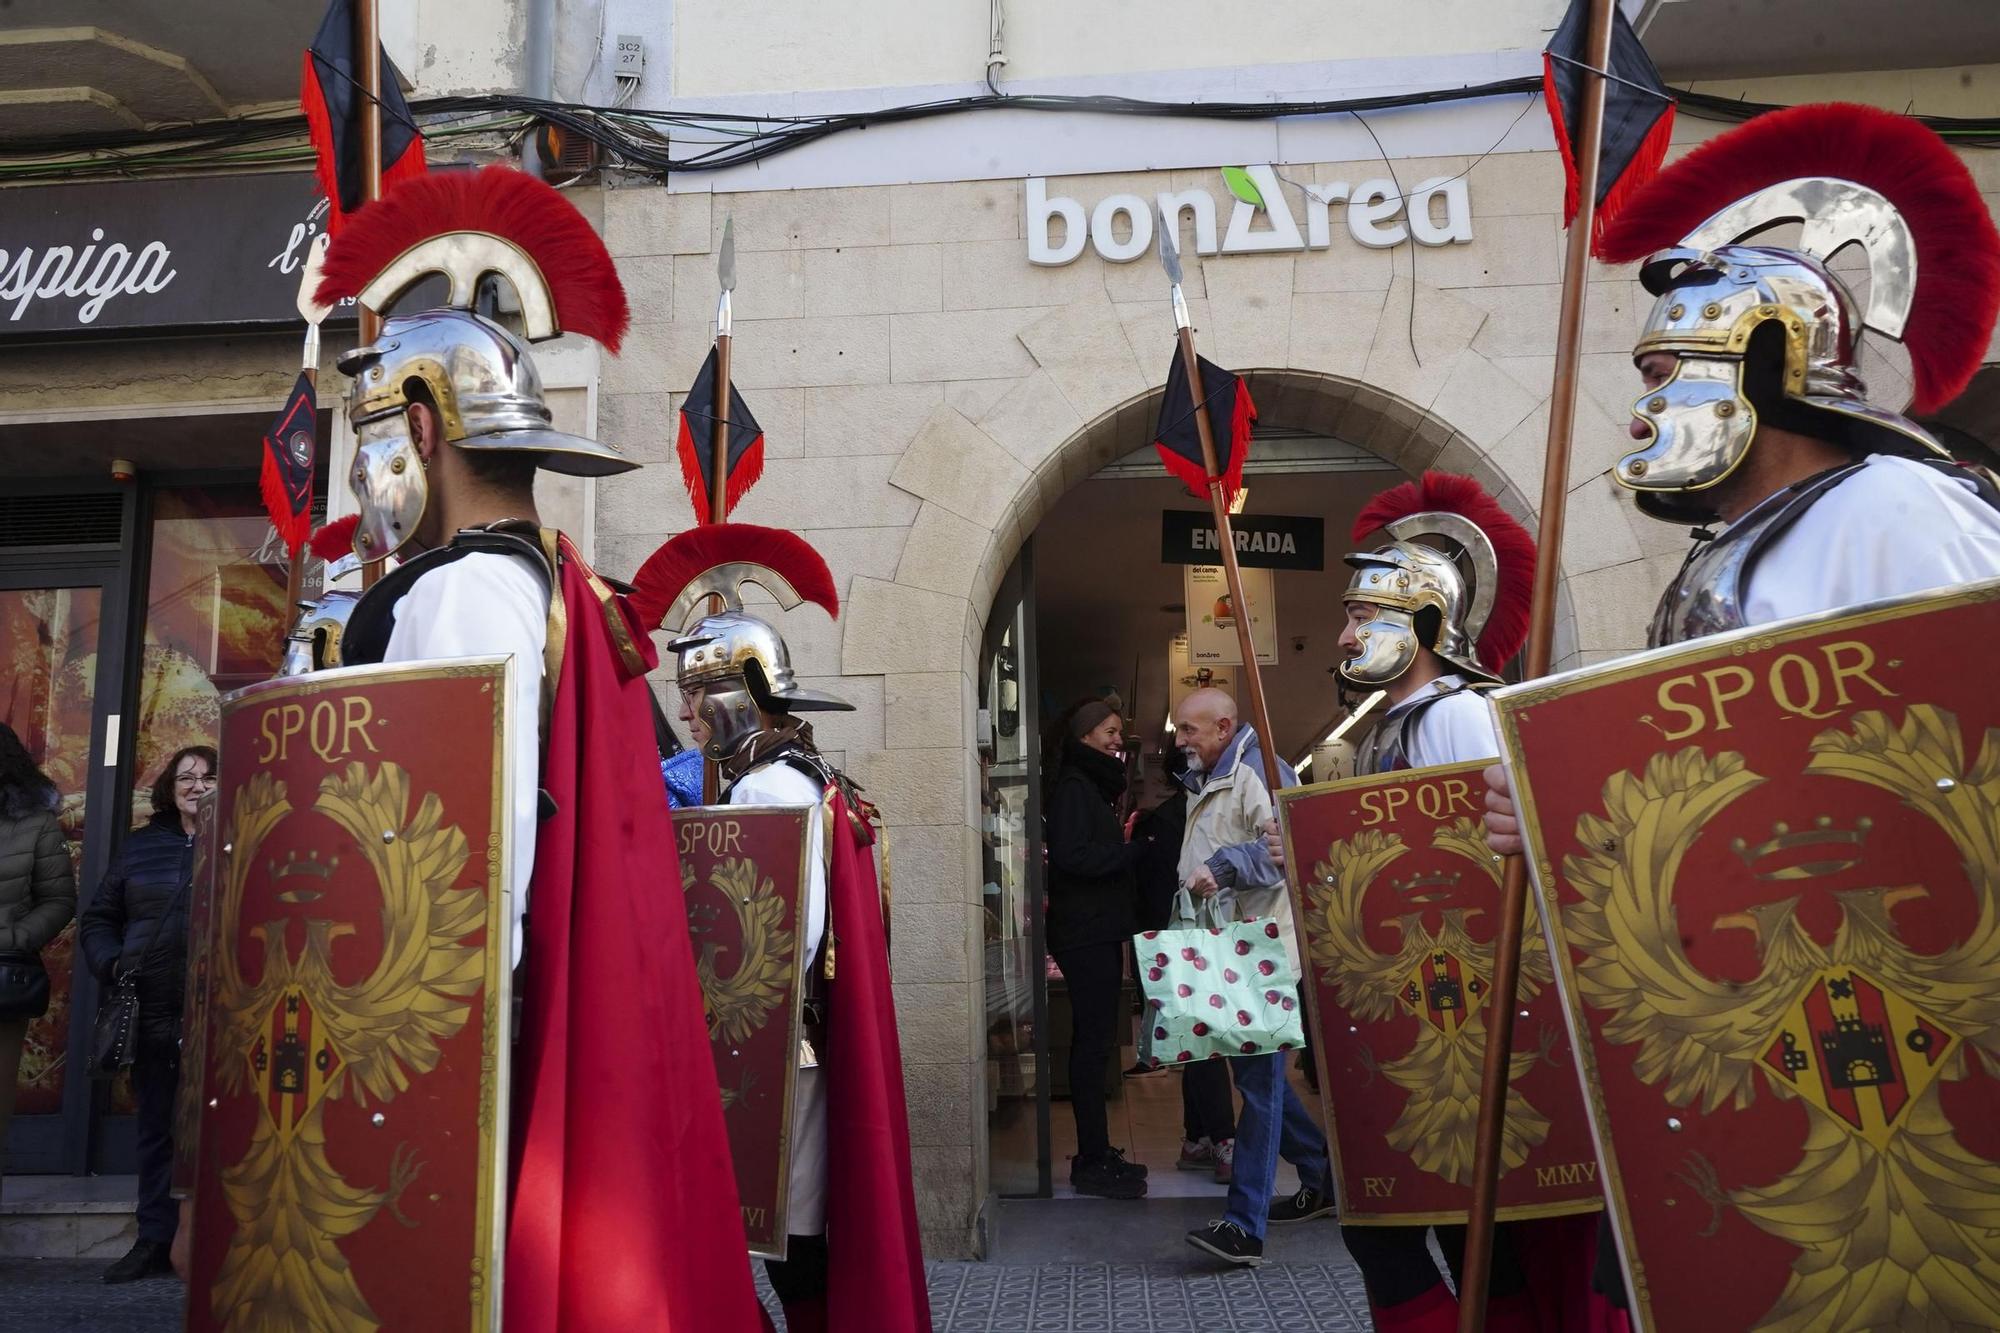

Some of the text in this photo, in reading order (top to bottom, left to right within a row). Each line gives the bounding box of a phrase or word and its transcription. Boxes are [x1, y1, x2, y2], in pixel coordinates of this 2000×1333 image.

[618, 42, 640, 52] 3C2
[622, 54, 635, 63] 27
[1191, 528, 1297, 554] ENRADA
[1657, 640, 1900, 741] SPQR
[259, 696, 379, 763] SPQR
[1360, 779, 1478, 826] SPQR
[679, 820, 743, 857] SPQR
[1363, 1177, 1397, 1197] RV
